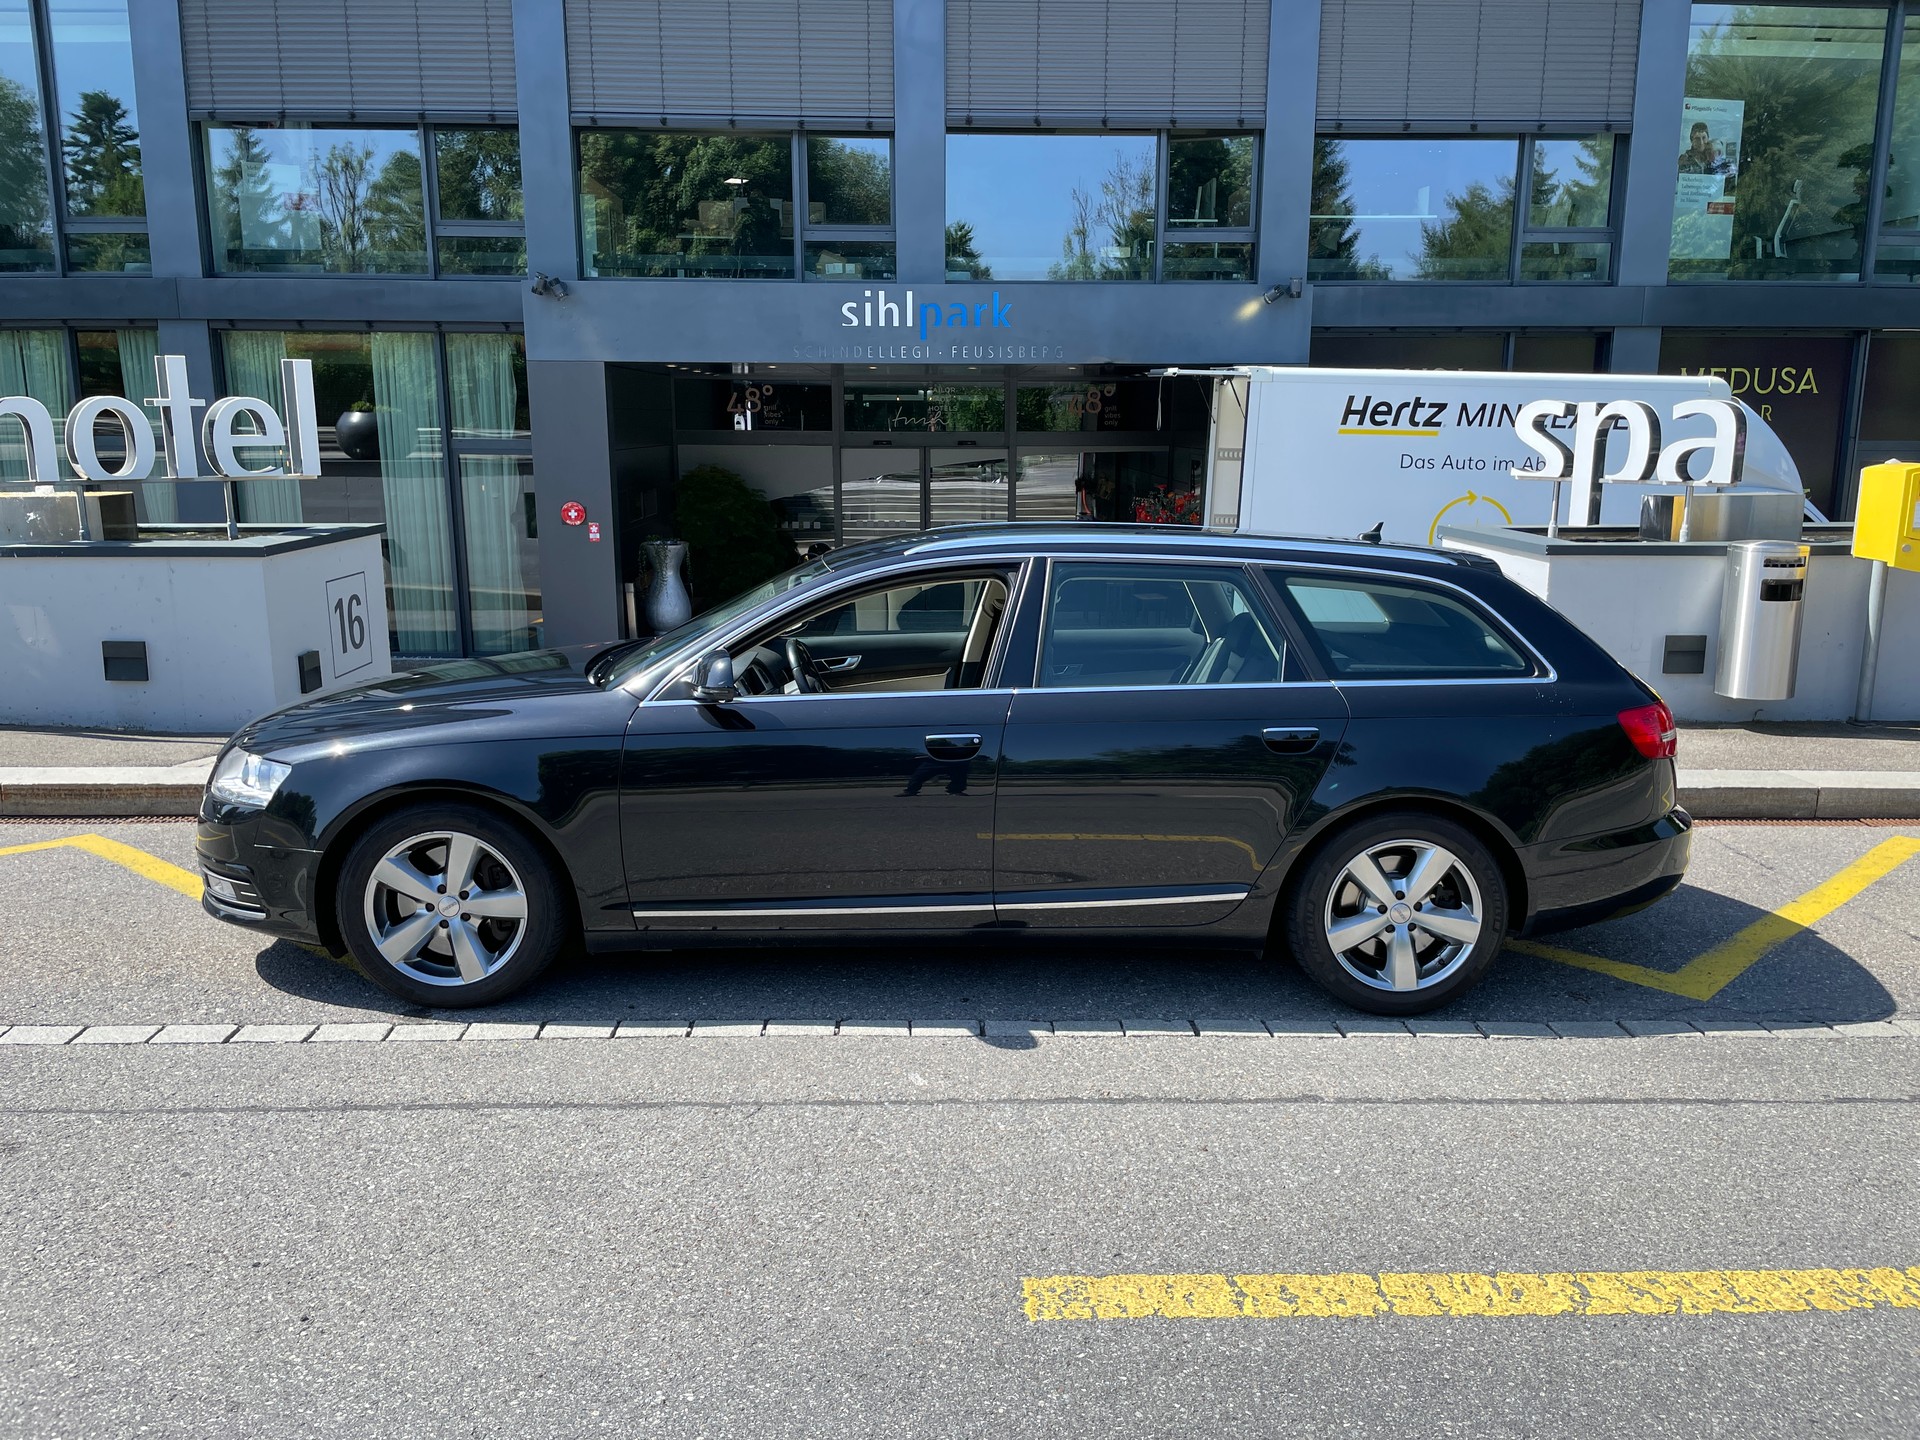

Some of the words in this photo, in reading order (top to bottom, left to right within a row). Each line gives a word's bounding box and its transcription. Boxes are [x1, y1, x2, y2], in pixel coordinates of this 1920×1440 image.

[841, 290, 1013, 341] sihlpark
[793, 345, 930, 359] SCHINDELLEGI
[1340, 395, 1448, 428] Hertz
[1400, 453, 1436, 470] Das
[1441, 454, 1486, 471] Auto
[1493, 455, 1514, 471] im
[1522, 456, 1547, 472] Ab
[1511, 399, 1748, 526] spa
[334, 593, 366, 654] 16
